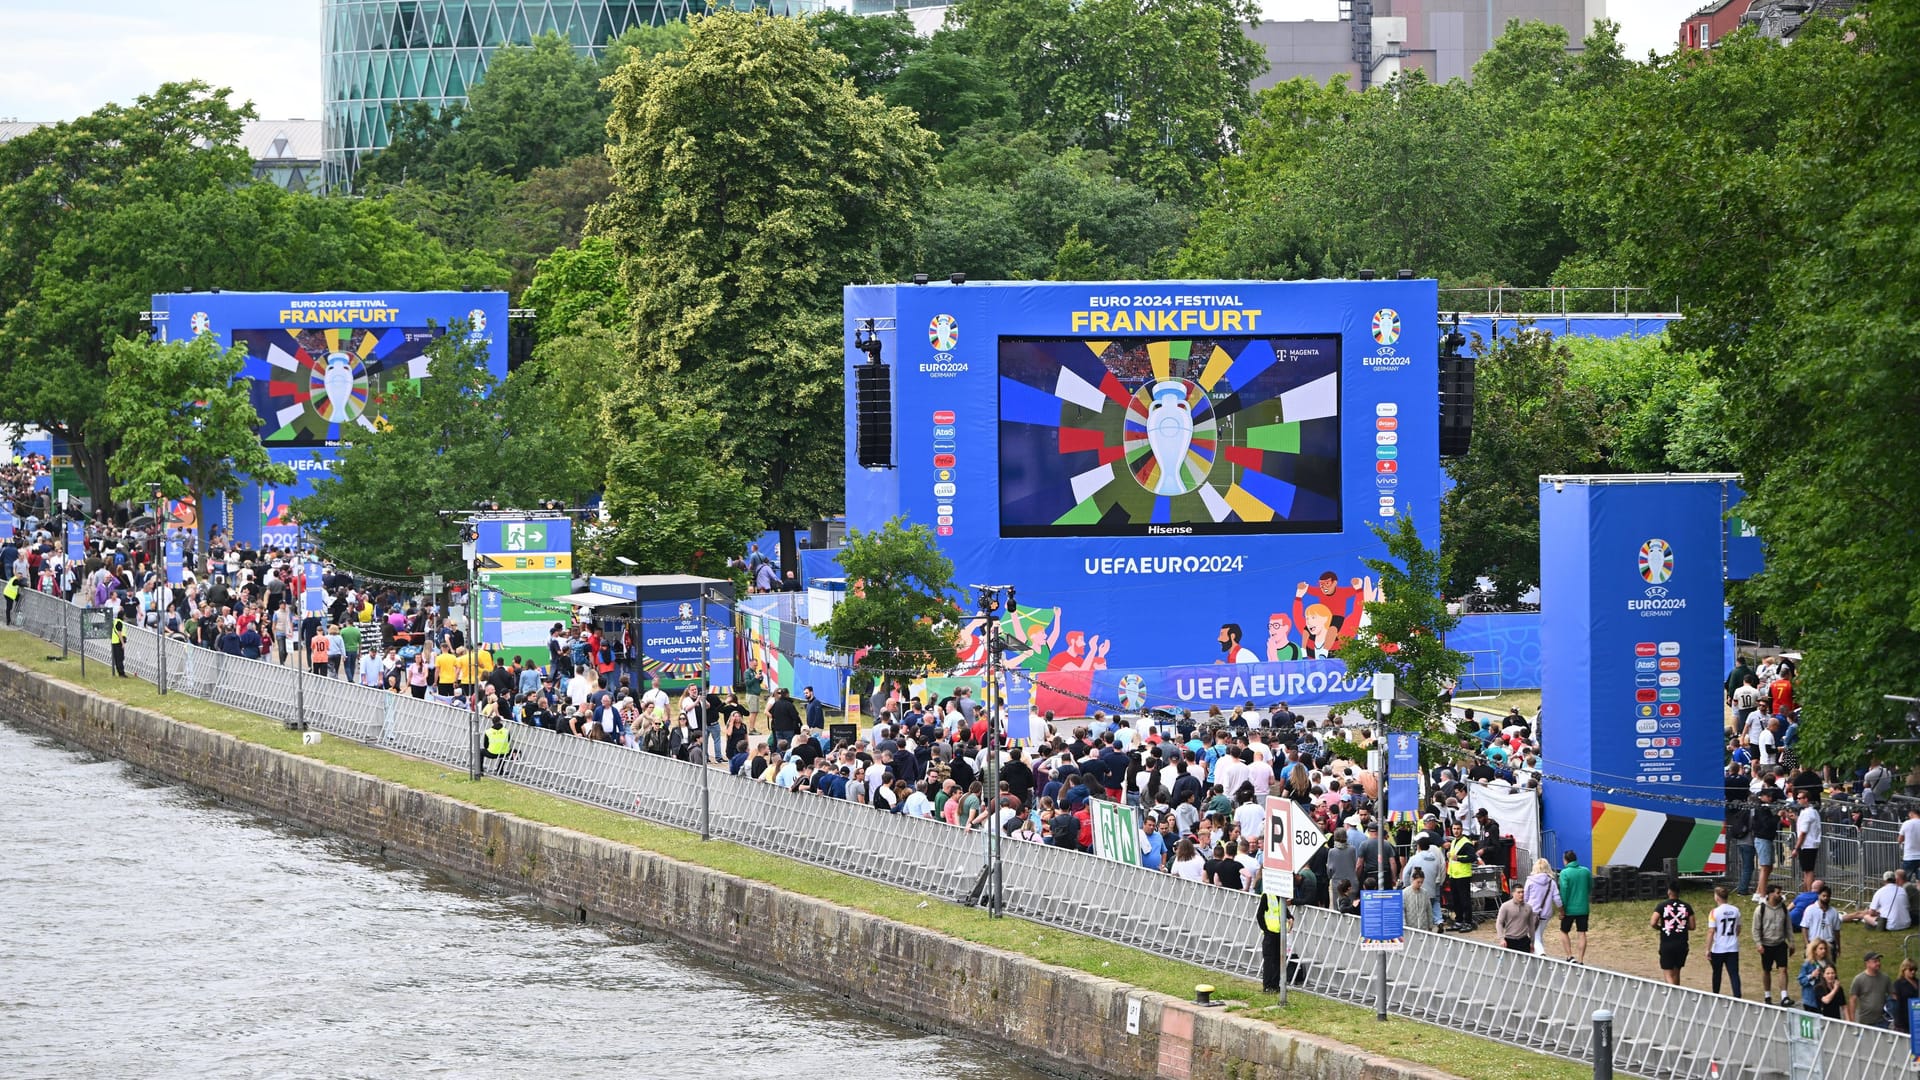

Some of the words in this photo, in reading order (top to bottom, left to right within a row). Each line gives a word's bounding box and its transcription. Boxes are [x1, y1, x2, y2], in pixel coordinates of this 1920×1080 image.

[318, 300, 343, 308] 2024
[1089, 296, 1131, 307] EURO
[1133, 296, 1172, 307] 2024
[1175, 295, 1243, 306] FESTIVAL
[279, 308, 399, 323] FRANKFURT
[1071, 309, 1262, 332] FRANKFURT
[919, 363, 968, 372] EURO2024
[1362, 357, 1410, 366] EURO2024
[1148, 525, 1193, 534] Hisense
[1084, 555, 1244, 574] UEFAEURO2024
[1627, 599, 1686, 610] EURO2024
[316, 641, 325, 652] 10
[647, 637, 685, 646] OFFICIAL
[1176, 671, 1374, 700] UEFAEURO202
[1777, 687, 1784, 699] 7
[1740, 694, 1752, 707] 10
[1271, 815, 1284, 852] P
[1295, 830, 1318, 846] 580
[1801, 1020, 1811, 1037] 11
